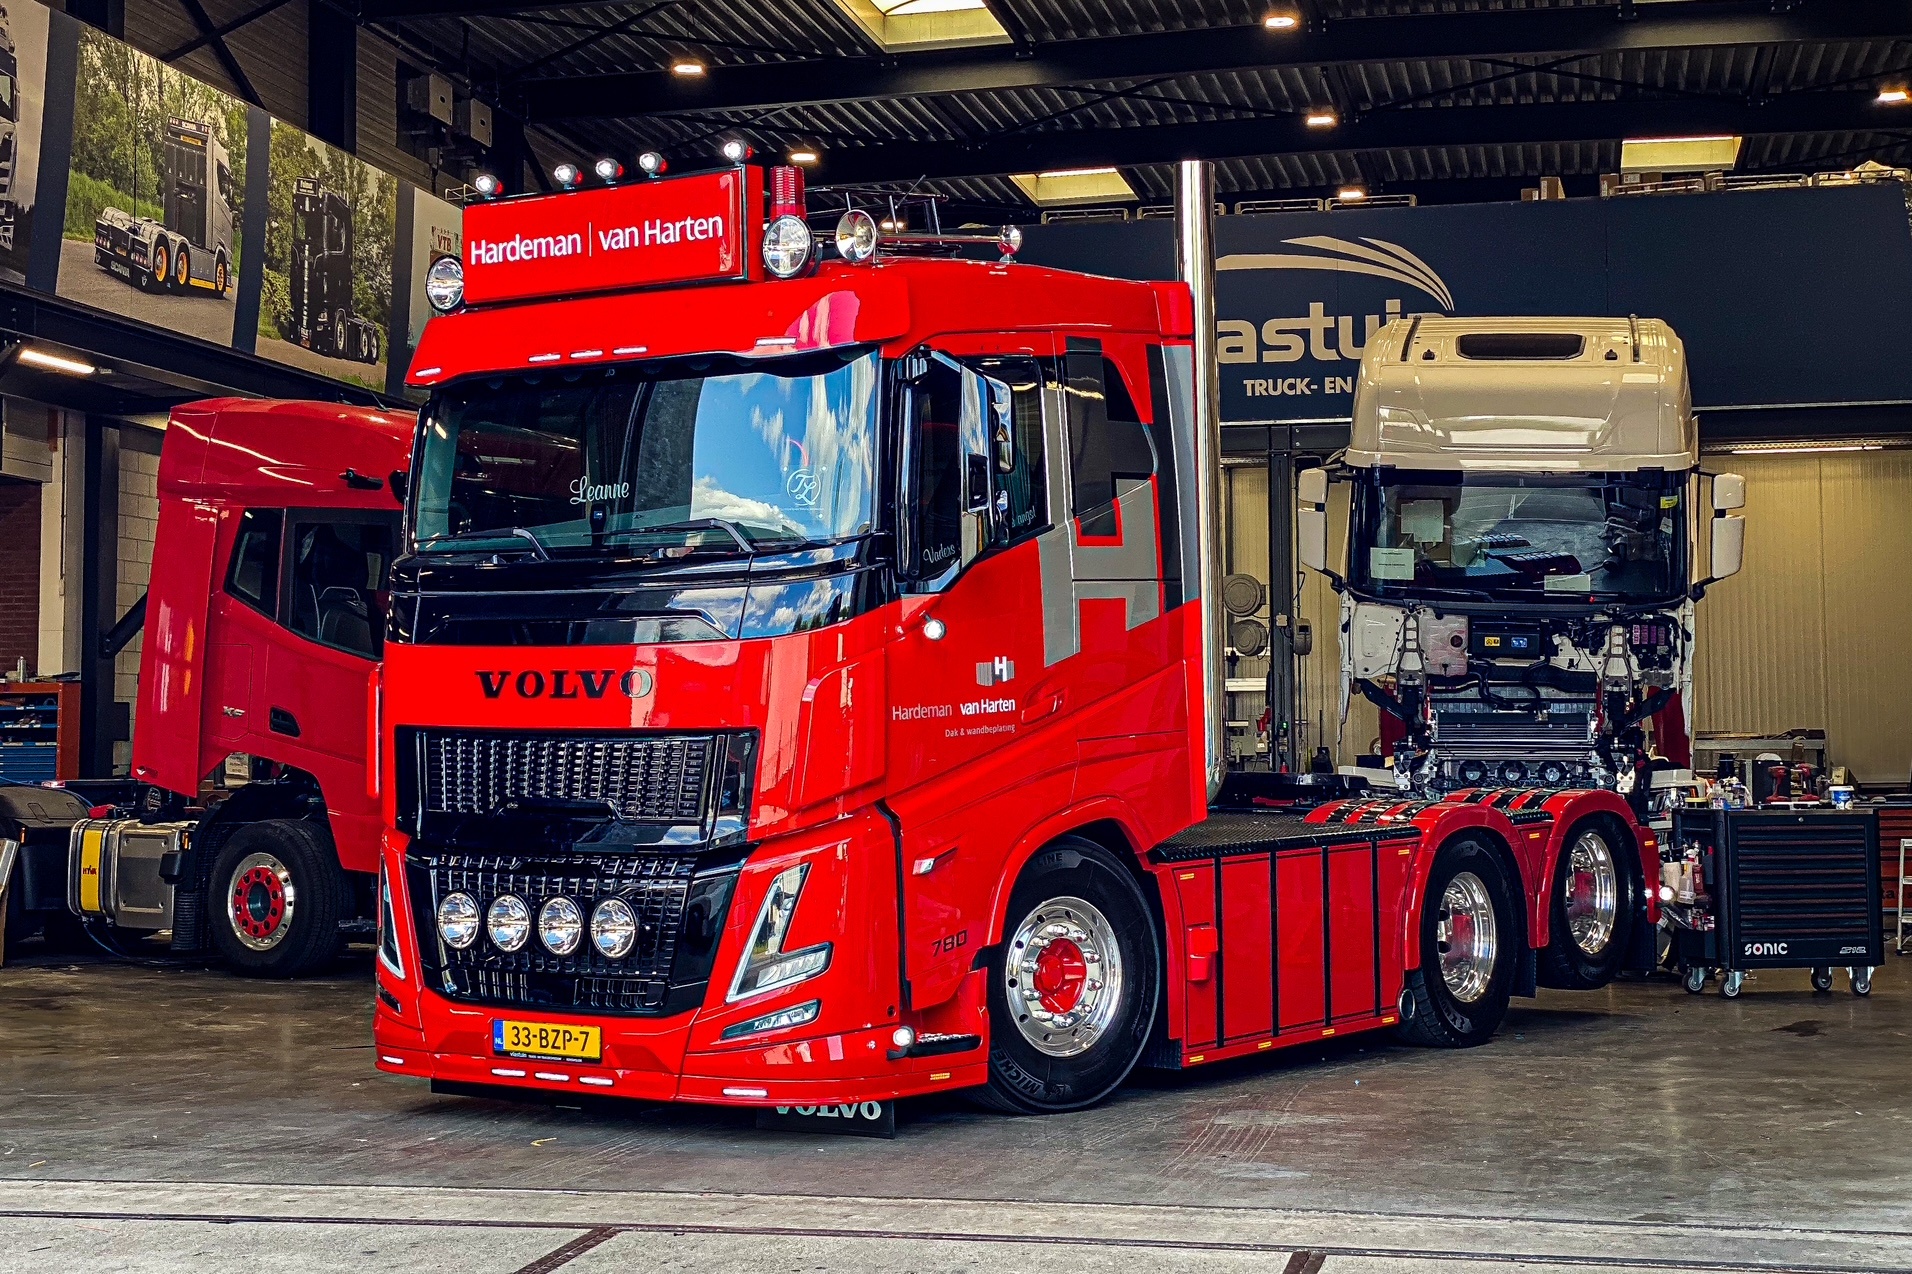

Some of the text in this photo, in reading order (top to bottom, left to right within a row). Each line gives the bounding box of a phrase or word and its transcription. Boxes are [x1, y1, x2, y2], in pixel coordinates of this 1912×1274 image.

[470, 215, 723, 265] Hardeman van Harten
[1243, 377, 1352, 396] TRUCK- EN
[569, 475, 630, 505] Leanne
[922, 543, 956, 563] Vaders
[474, 669, 653, 699] VOLVO
[892, 698, 1016, 720] Hardeman van Harten
[945, 724, 1016, 738] Dak & wandbeplating
[931, 929, 968, 957] 780
[1744, 943, 1788, 956] SONIC
[511, 1026, 590, 1052] 33-BZP-7
